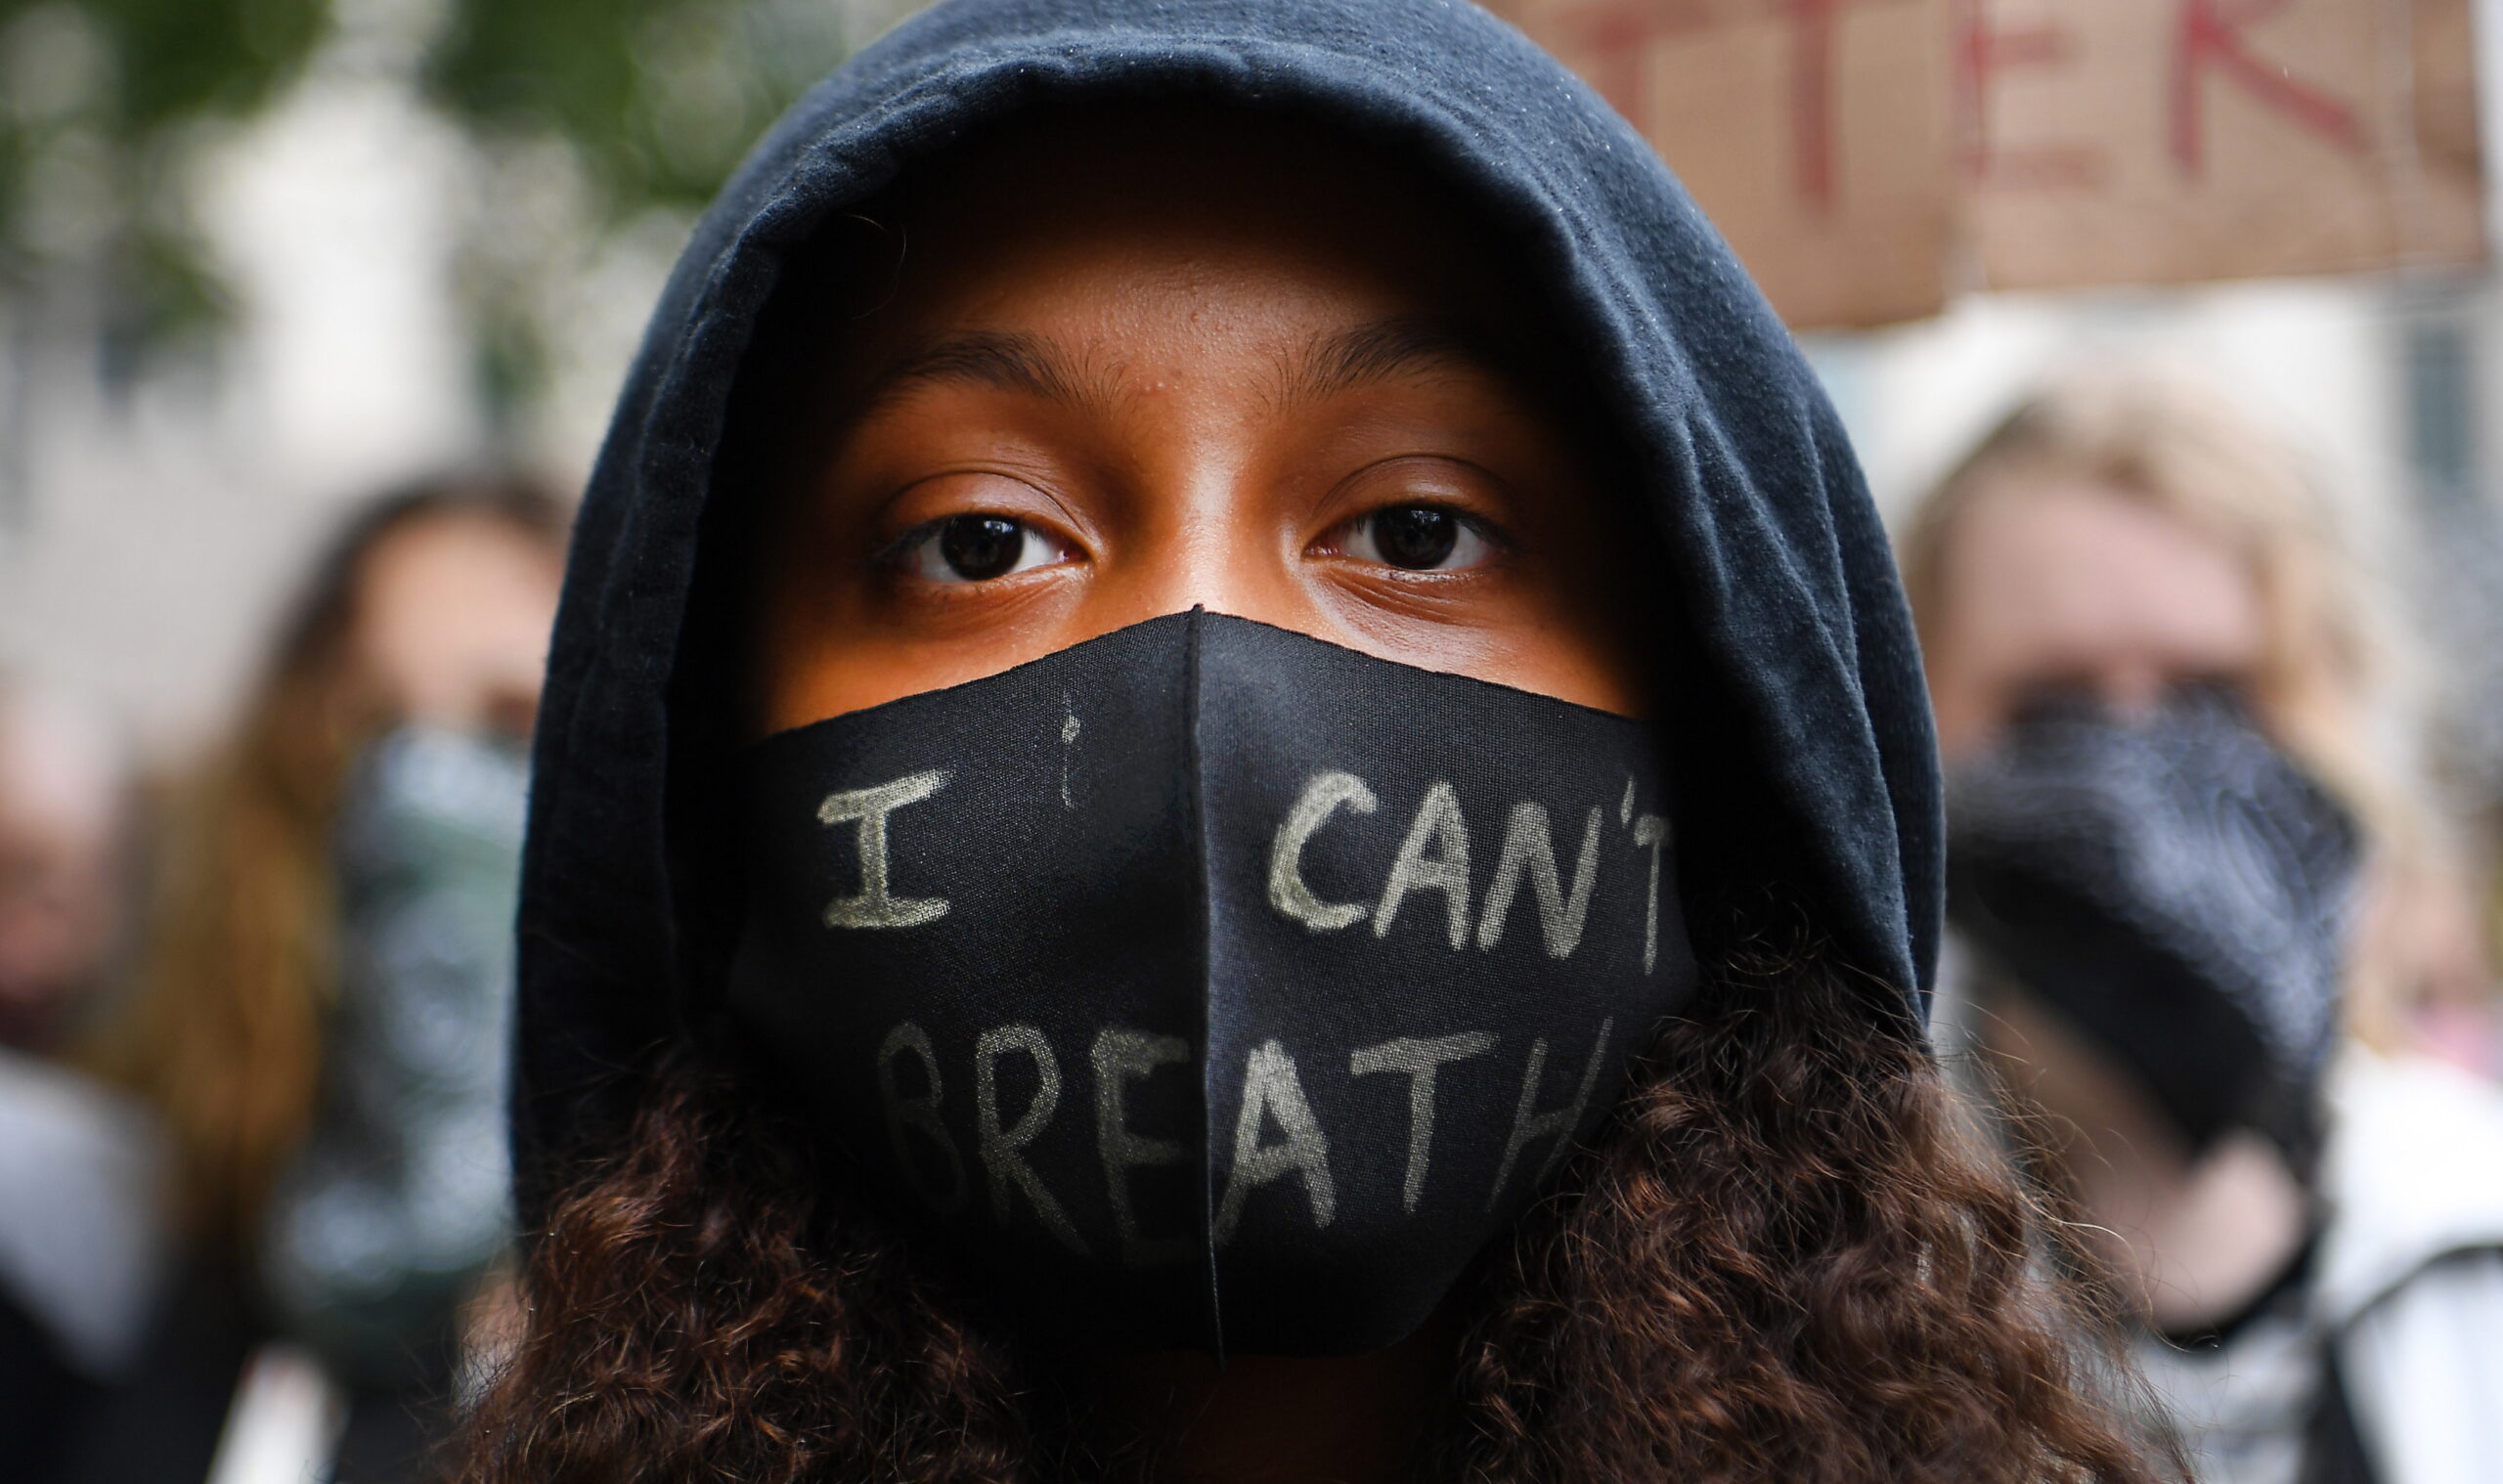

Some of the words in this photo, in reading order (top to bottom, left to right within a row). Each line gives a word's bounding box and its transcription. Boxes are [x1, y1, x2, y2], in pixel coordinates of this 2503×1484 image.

[817, 768, 954, 929] I
[1268, 770, 1673, 976] CAN'T
[878, 1017, 1613, 1267] BREATH
